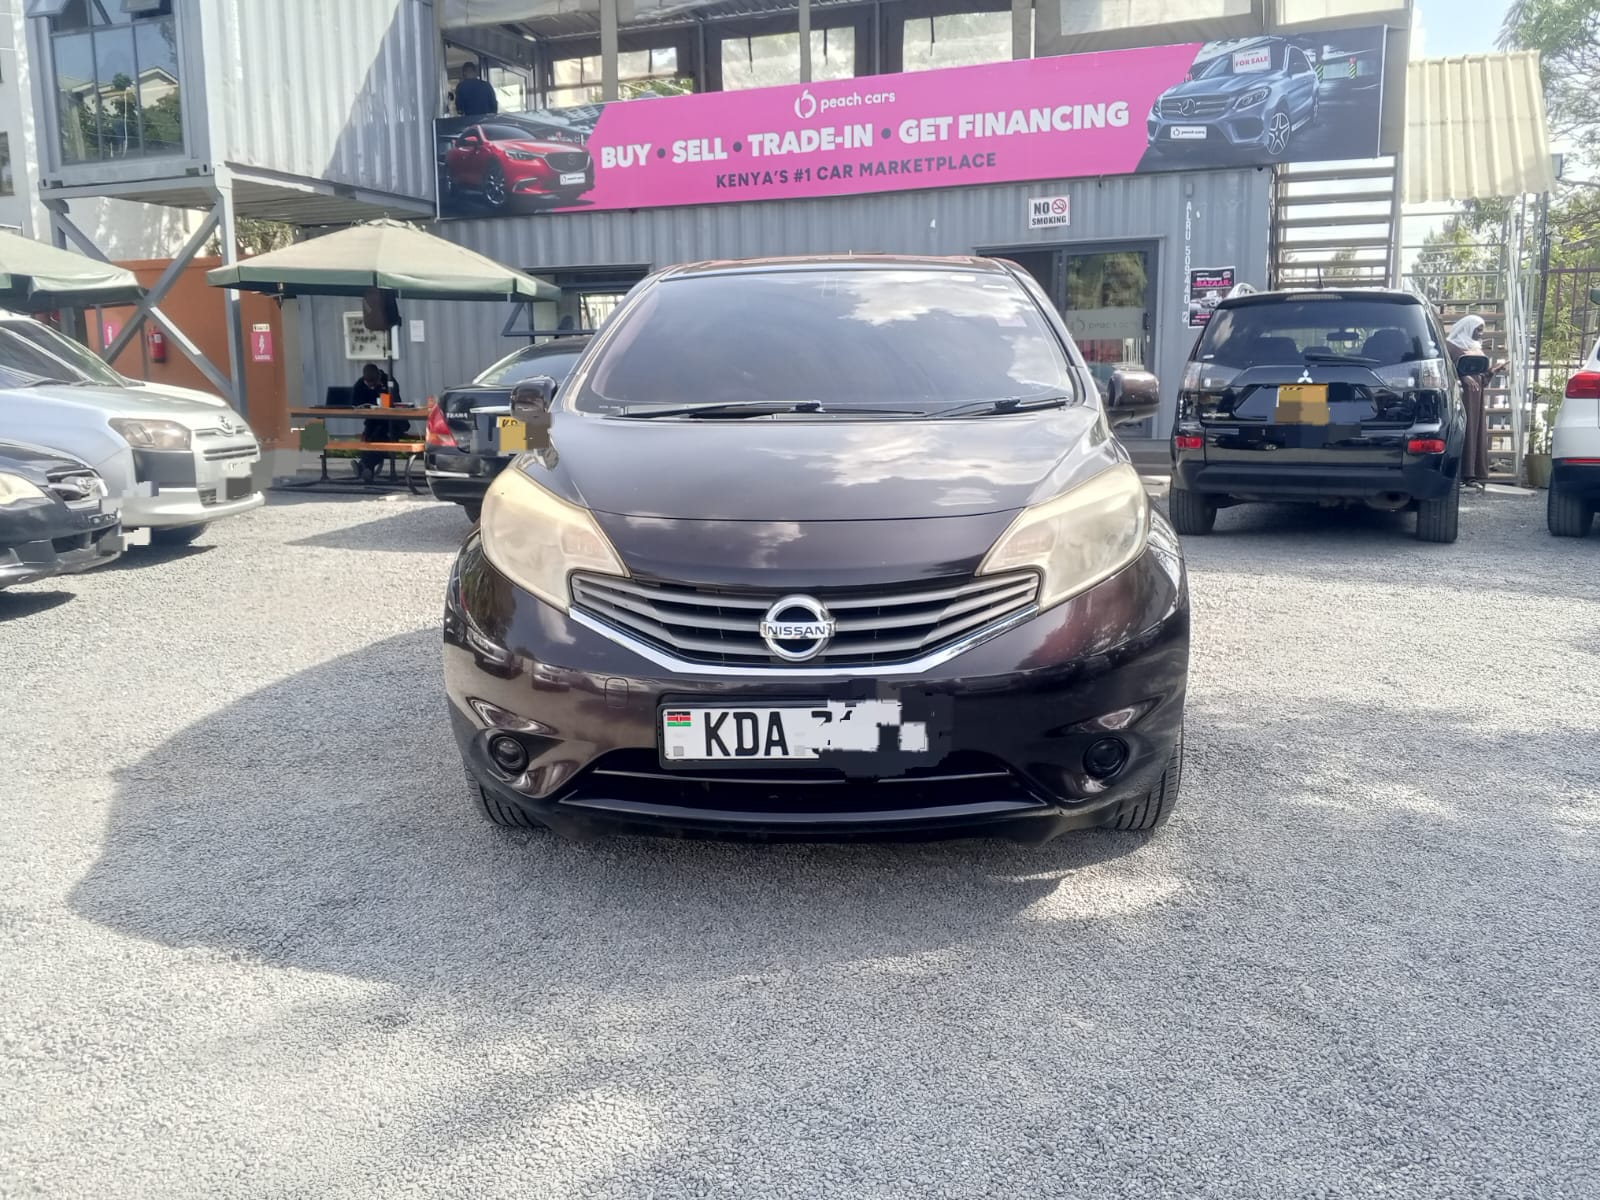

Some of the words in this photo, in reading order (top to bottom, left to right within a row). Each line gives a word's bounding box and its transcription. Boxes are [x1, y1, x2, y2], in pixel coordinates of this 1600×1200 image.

[1235, 59, 1250, 67] FOR
[1251, 55, 1269, 64] SALE
[820, 92, 862, 113] peach
[864, 92, 896, 104] cars
[600, 143, 652, 169] BUY
[671, 137, 728, 164] SELL
[747, 123, 873, 157] TRADE-IN
[899, 115, 953, 144] GET
[958, 101, 1130, 140] FINANCING
[793, 167, 811, 183] #1
[816, 164, 853, 181] CAR
[859, 152, 996, 177] MARKETPLACE
[1033, 201, 1050, 216] NO
[1031, 215, 1067, 226] SMOKING
[767, 626, 826, 636] NISSAN
[703, 711, 790, 757] KDA
